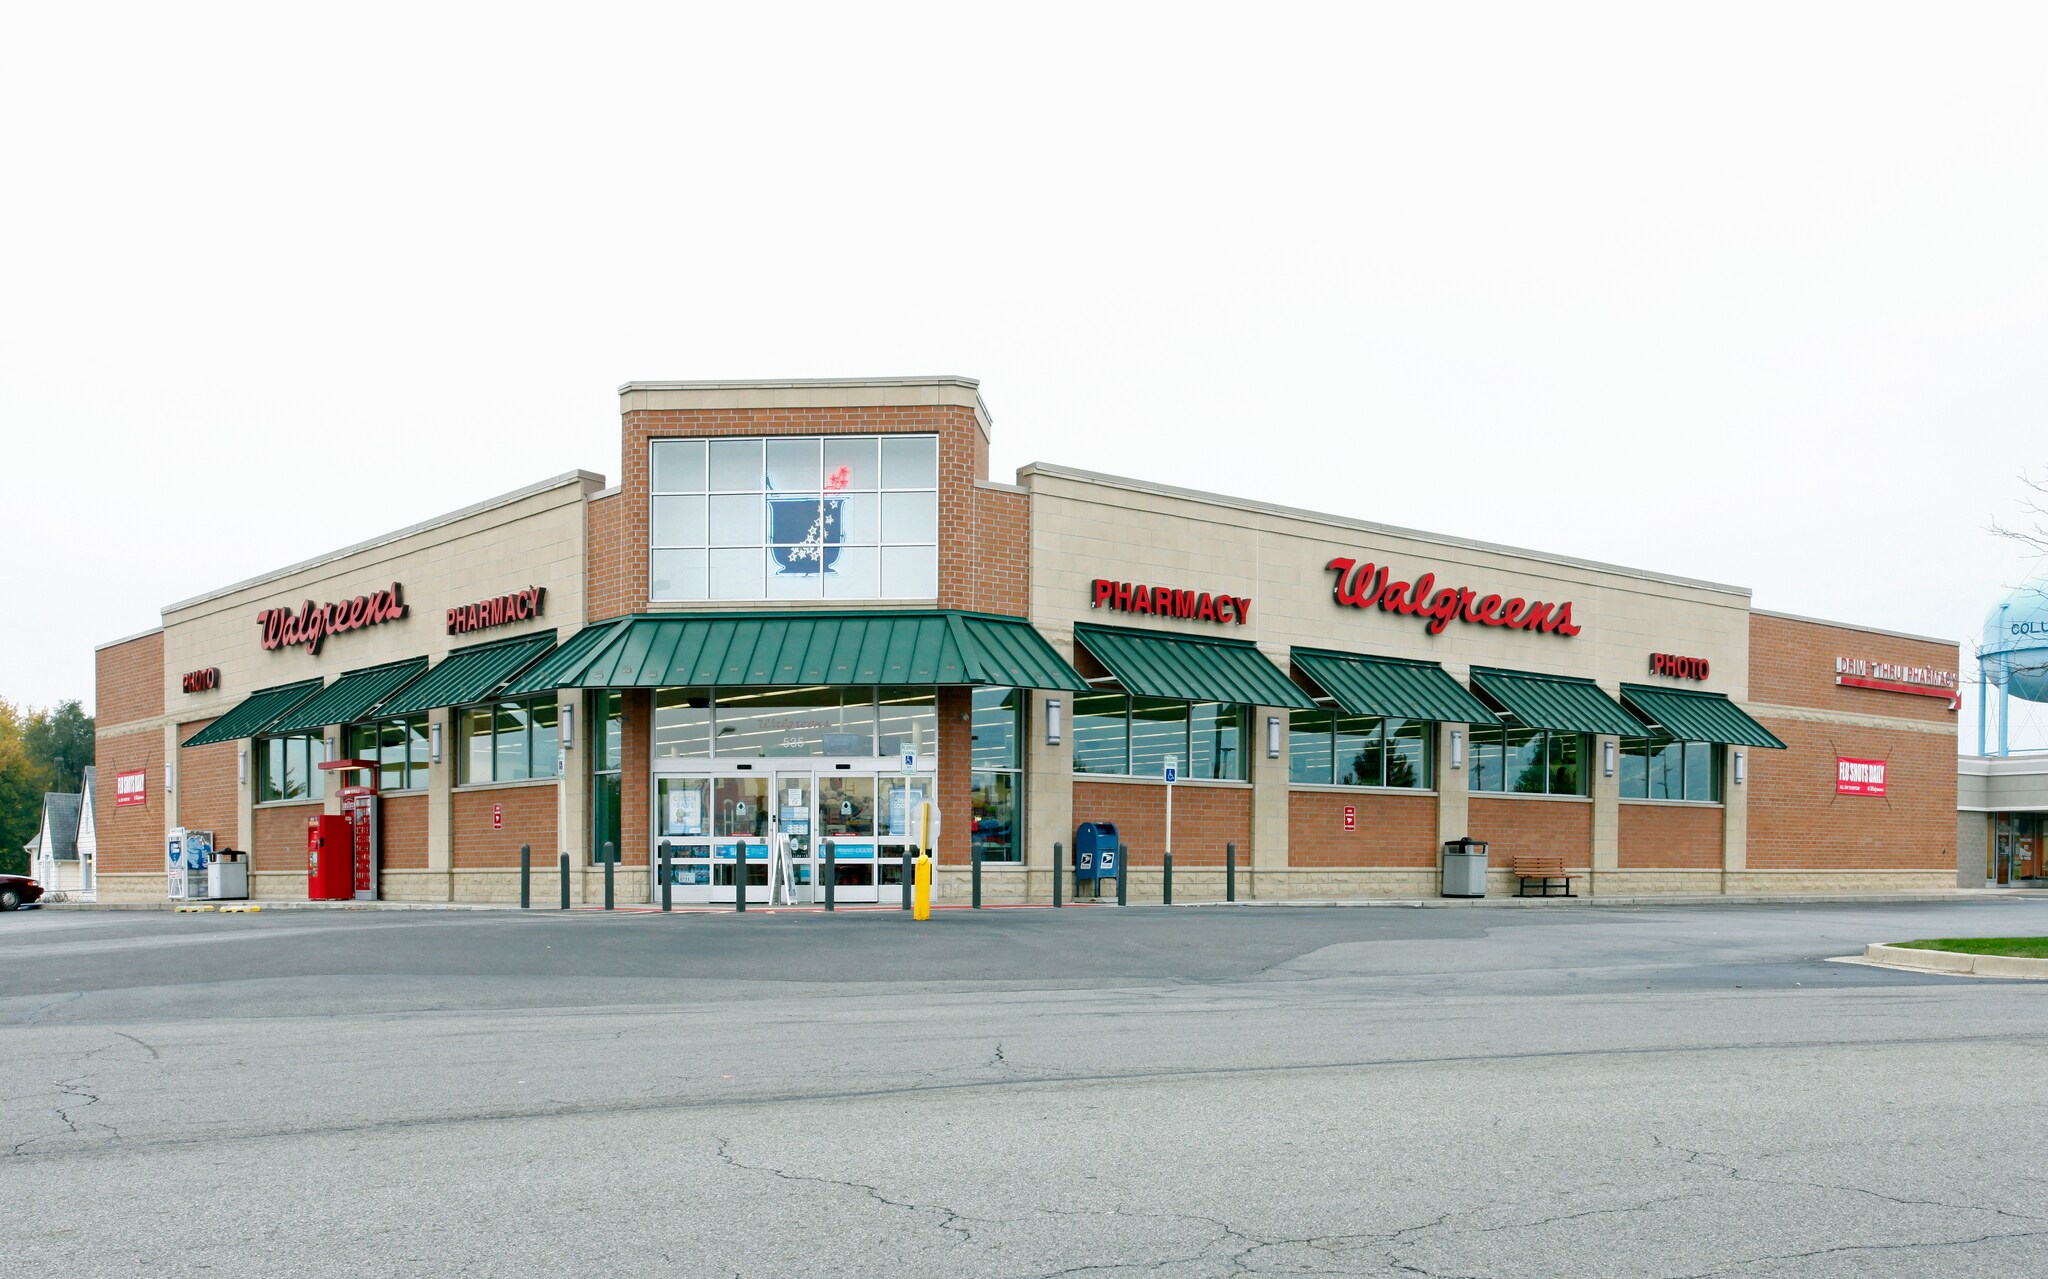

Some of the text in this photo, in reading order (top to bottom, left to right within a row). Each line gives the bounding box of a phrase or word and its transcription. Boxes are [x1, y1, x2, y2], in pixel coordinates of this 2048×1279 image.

[447, 587, 545, 635] PHARMACY
[1093, 579, 1251, 624] PHARMACY
[1327, 557, 1581, 636] Walgreens
[257, 582, 408, 655] Walgreens
[183, 667, 220, 693] PHOTO
[1650, 653, 1709, 680] PHOTO
[1837, 657, 1956, 687] DRIVE THRU PHARMACY
[758, 718, 832, 733] Walgreens
[1850, 763, 1868, 783] SHOTS
